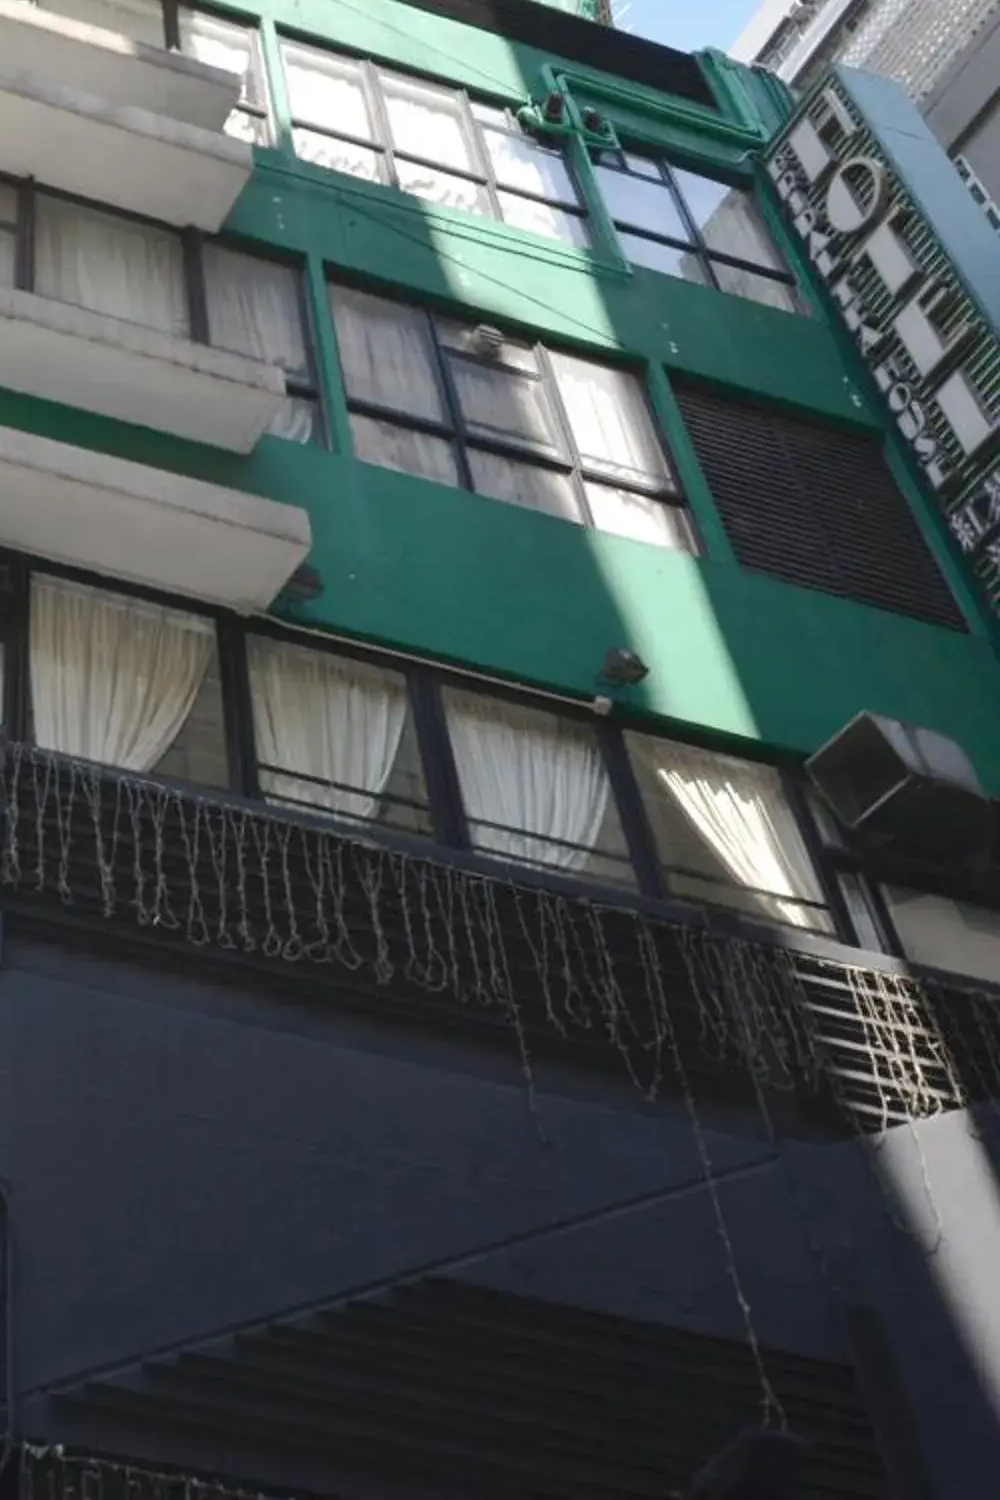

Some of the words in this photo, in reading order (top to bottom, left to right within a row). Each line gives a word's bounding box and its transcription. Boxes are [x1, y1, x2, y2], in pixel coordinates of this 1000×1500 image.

[766, 153, 841, 277] BRIDAL
[831, 275, 884, 359] TEA
[872, 354, 952, 491] HOUSE
[788, 88, 1000, 456] HOTEL
